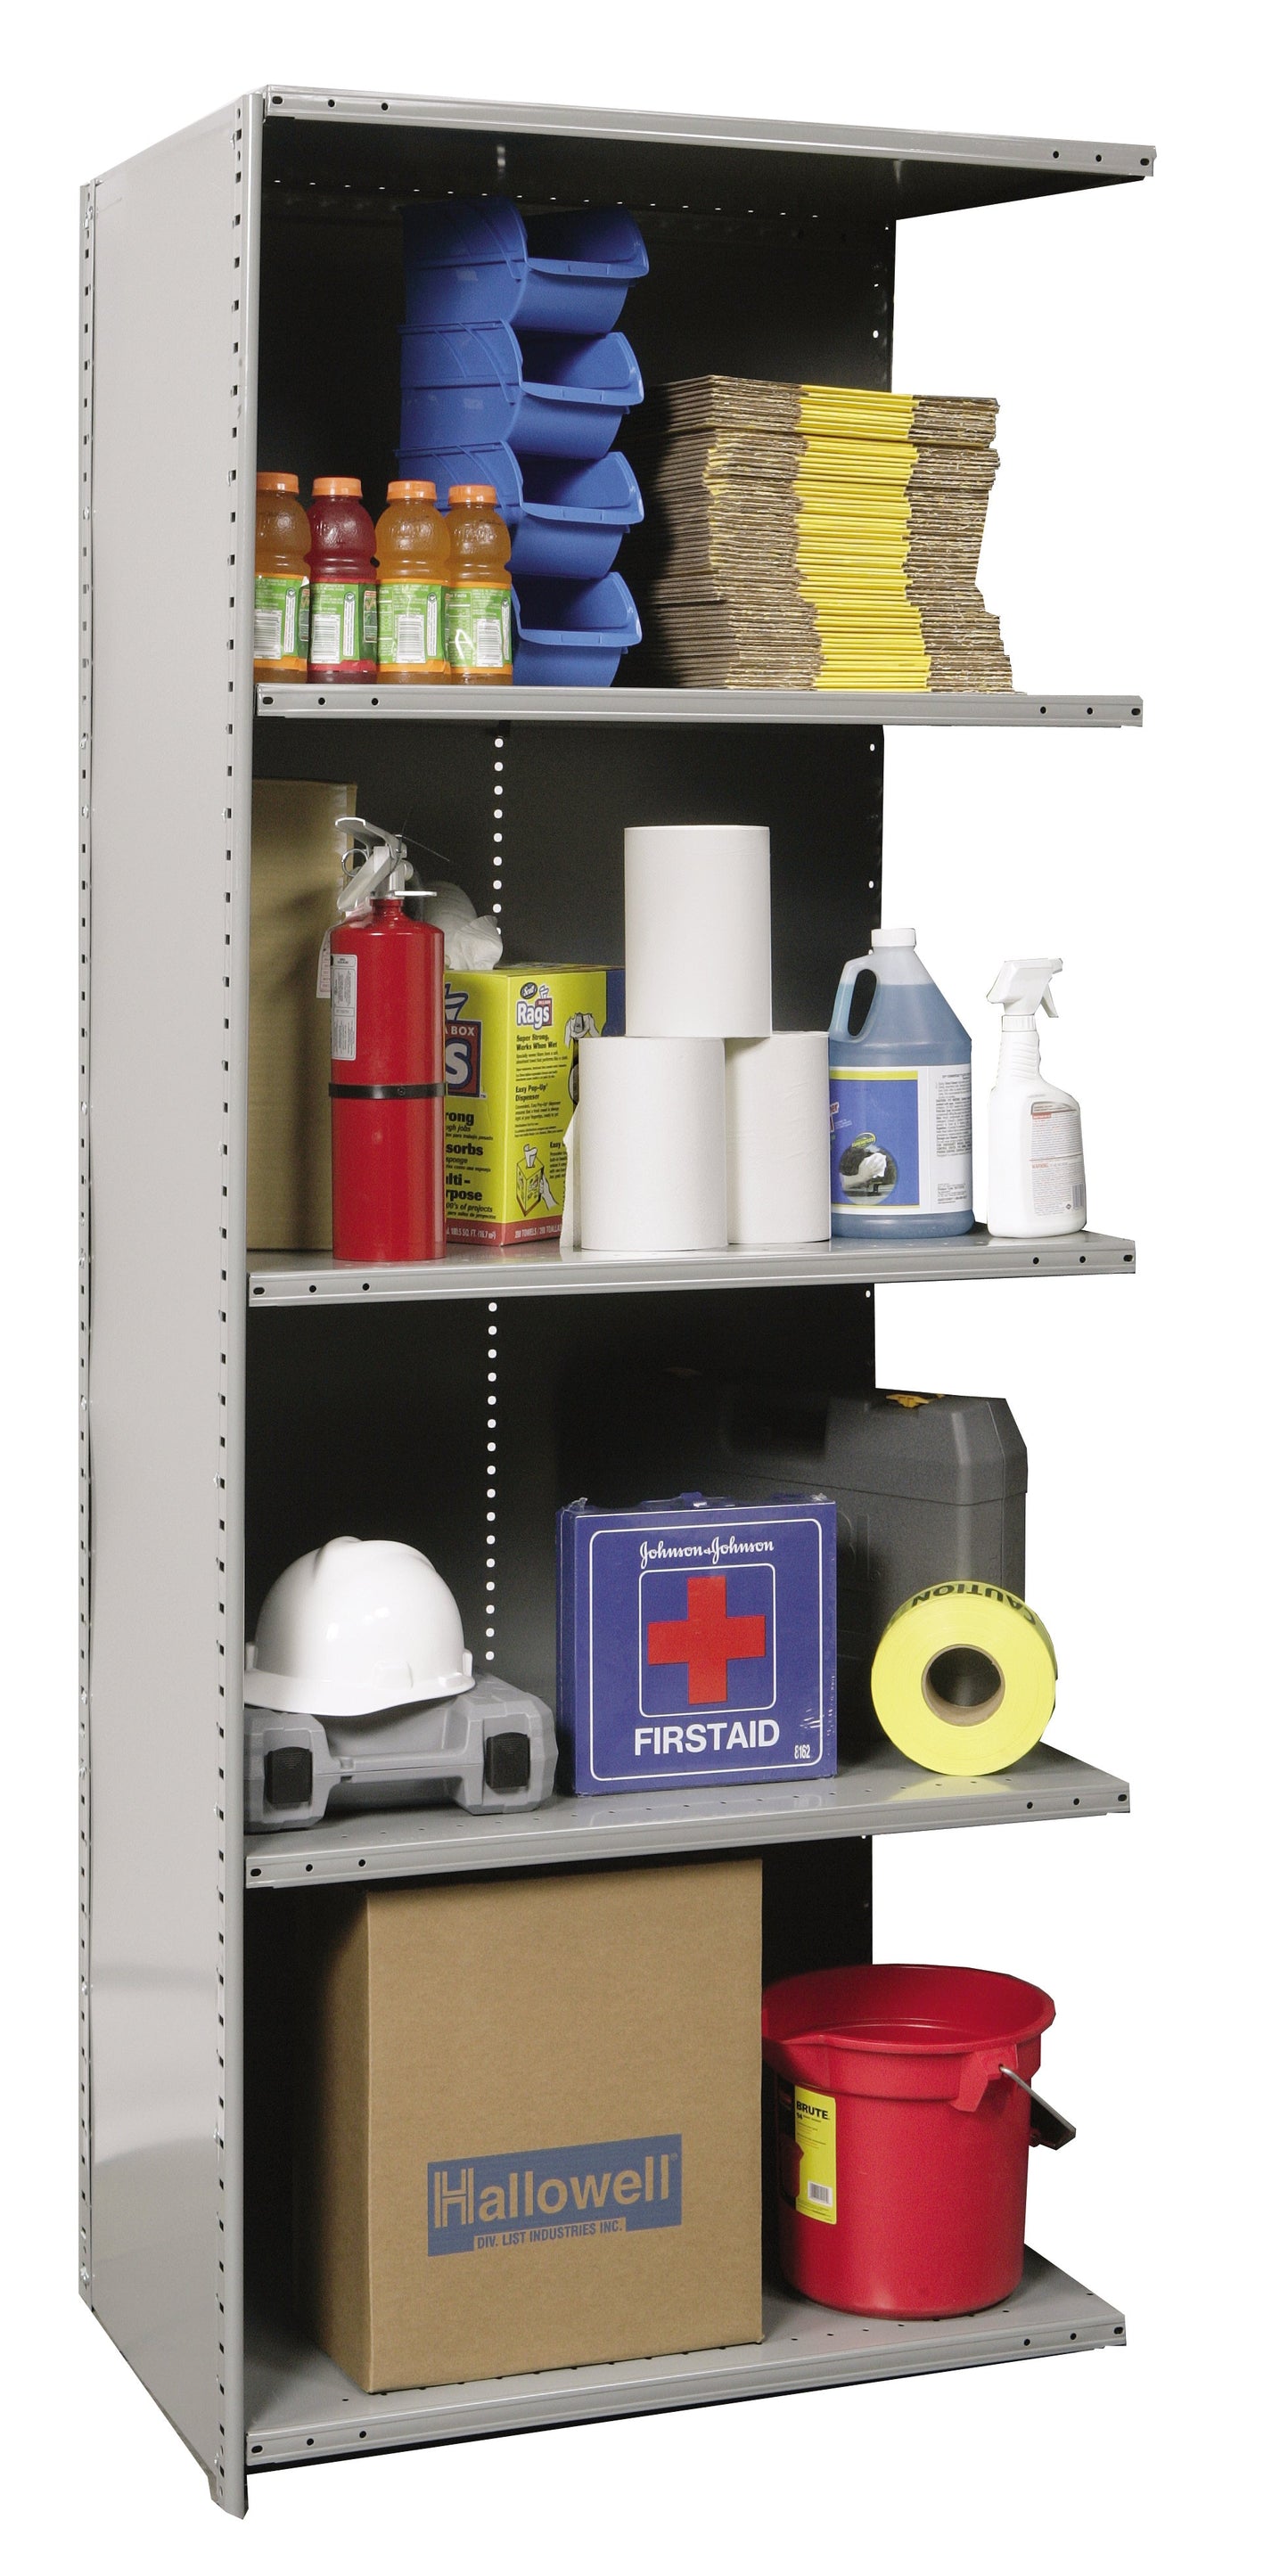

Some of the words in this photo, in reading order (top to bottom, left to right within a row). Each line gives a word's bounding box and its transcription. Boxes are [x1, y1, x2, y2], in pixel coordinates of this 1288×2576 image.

[516, 1001, 551, 1030] Rags
[451, 1025, 475, 1037] BOX
[516, 1034, 531, 1043] Super
[515, 1094, 540, 1103] Dispenser
[456, 1124, 472, 1133] jobs
[446, 1142, 484, 1156] sorbs
[467, 1205, 493, 1213] projects
[911, 1583, 1037, 1625] CAUTION
[793, 1743, 811, 1760] 8162
[796, 2100, 829, 2121] BRUTE
[477, 2235, 499, 2250] DIV.
[502, 2231, 526, 2247] LIST
[529, 2223, 596, 2243] INDUSTRIES
[600, 2219, 624, 2235] INC.
